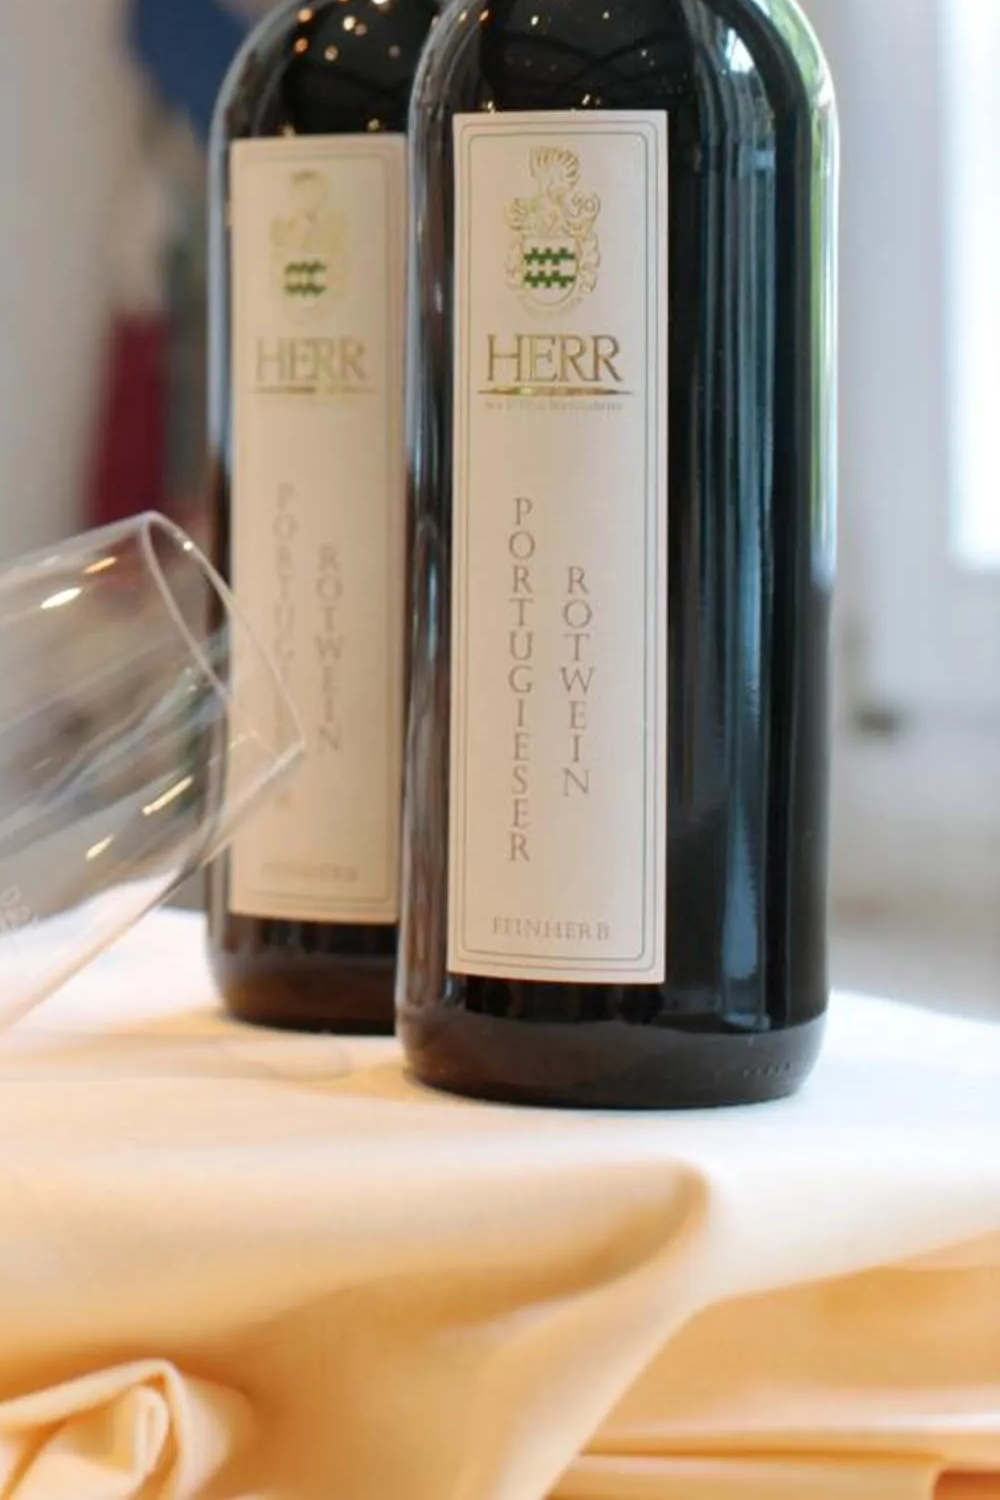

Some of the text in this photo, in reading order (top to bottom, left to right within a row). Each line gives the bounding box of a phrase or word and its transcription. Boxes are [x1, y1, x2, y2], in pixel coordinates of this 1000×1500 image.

[255, 337, 368, 382] HERR
[486, 334, 623, 383] HERR
[315, 545, 343, 752] ROTWEIN
[508, 496, 535, 862] PORTUGIESER
[561, 565, 594, 798] ROTWEIN
